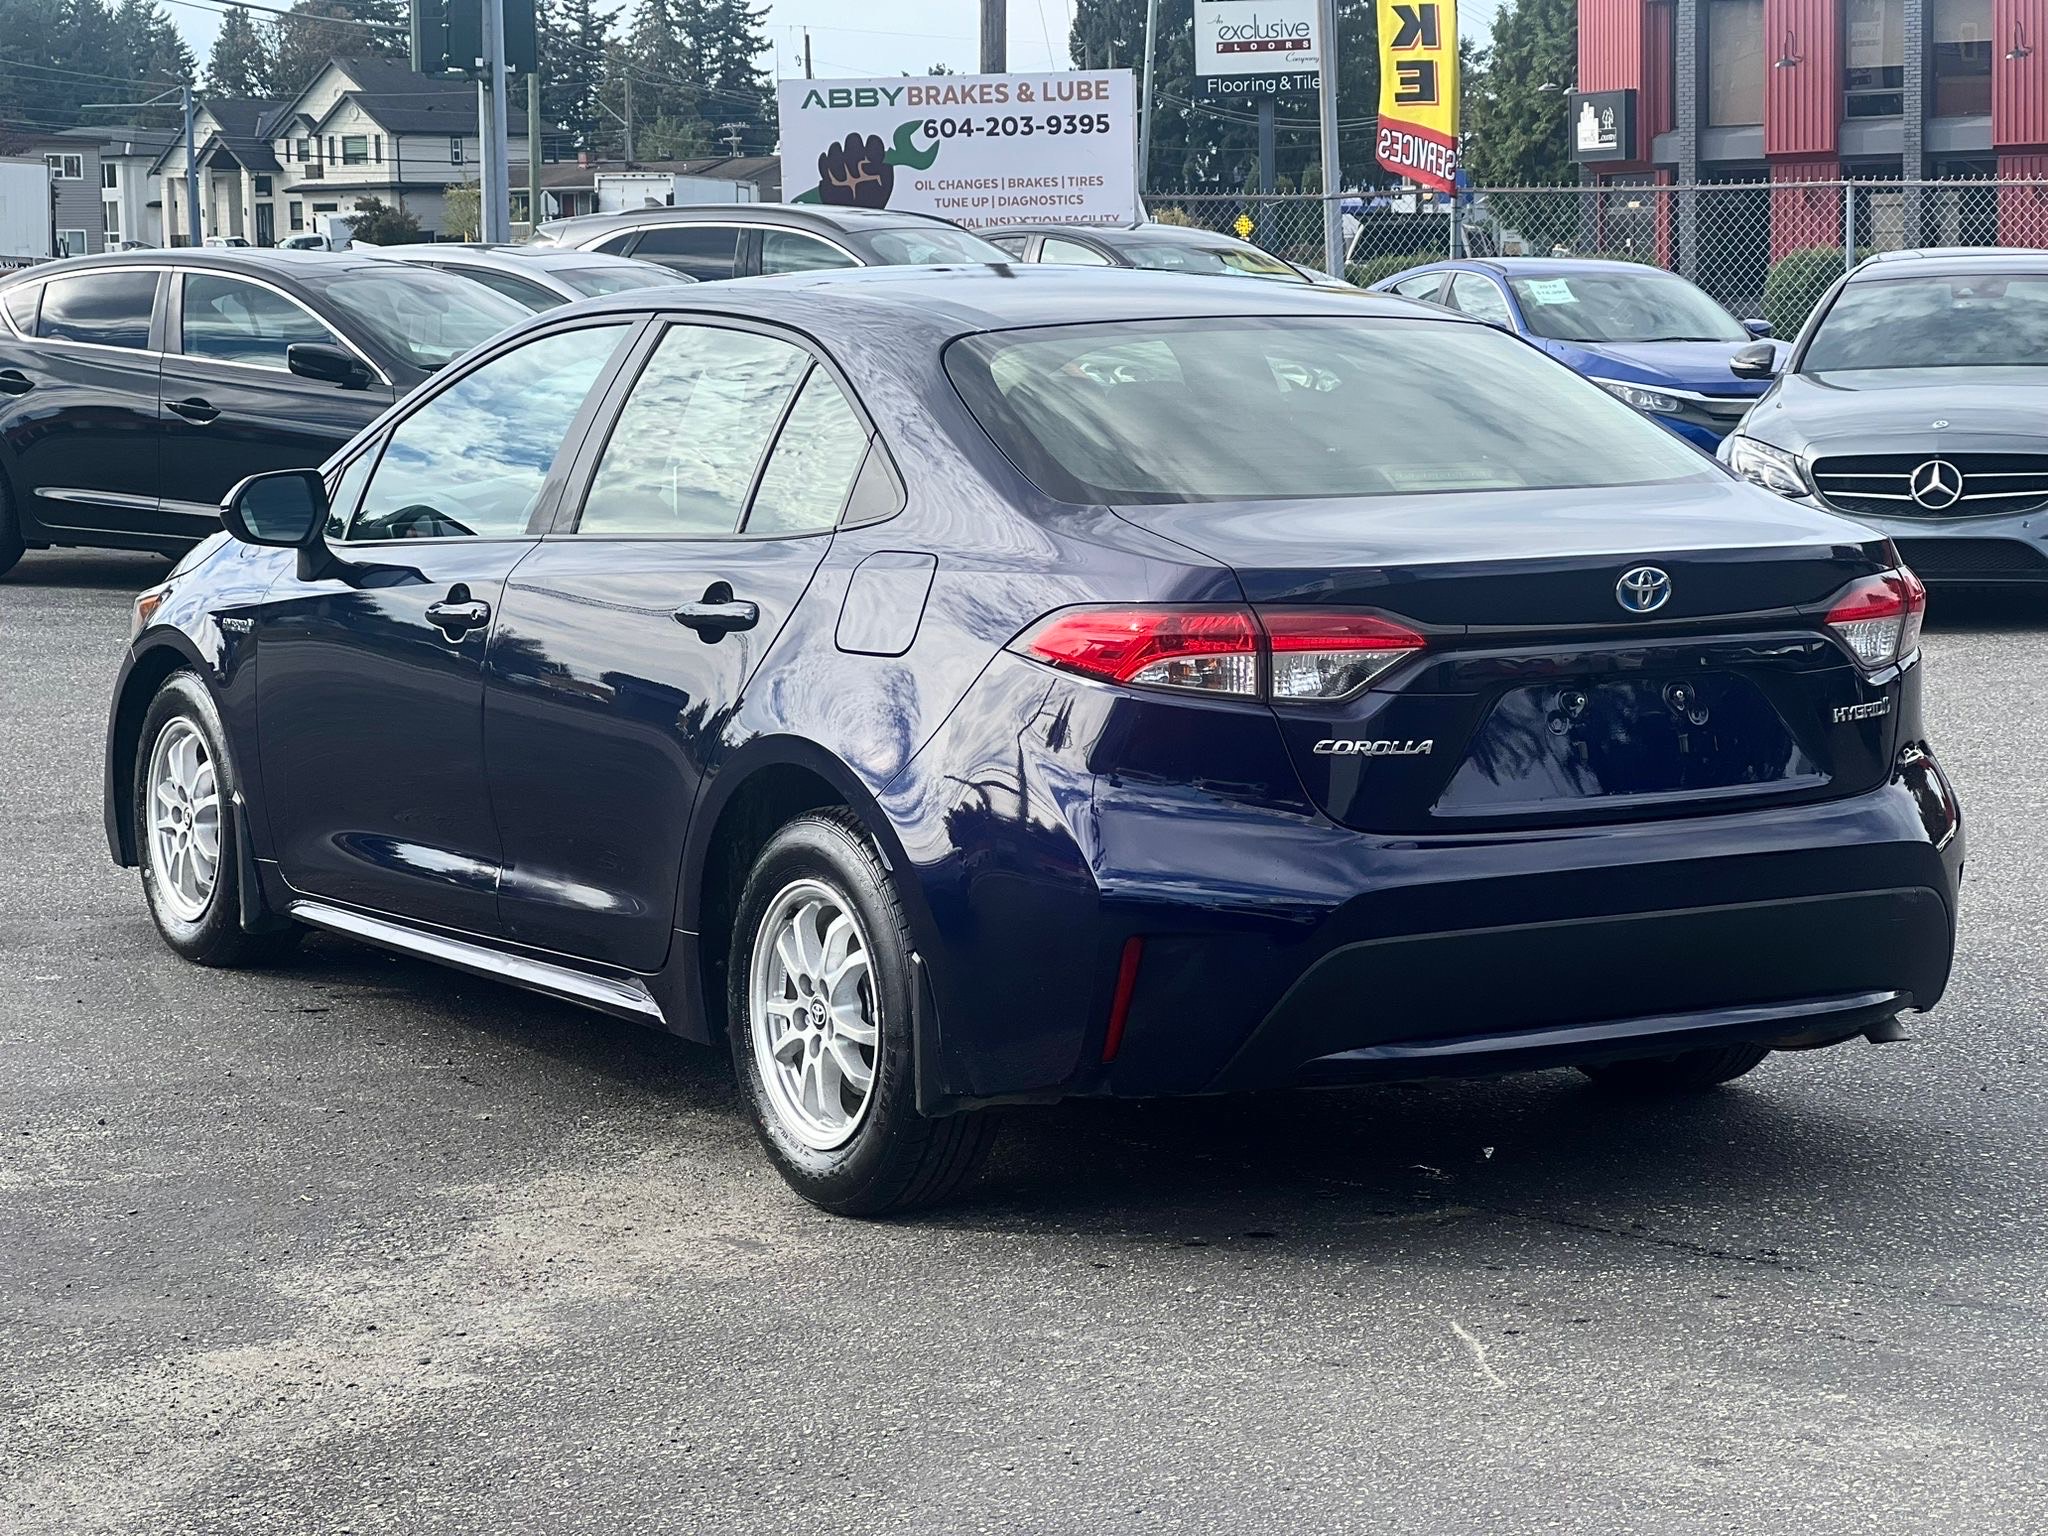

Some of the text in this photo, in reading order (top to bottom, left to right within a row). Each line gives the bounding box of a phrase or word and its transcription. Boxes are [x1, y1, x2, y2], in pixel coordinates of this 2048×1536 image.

[1218, 13, 1310, 40] exclusive
[1217, 40, 1310, 52] FLOORS
[1207, 77, 1276, 93] Flooring
[1279, 75, 1292, 91] &
[801, 80, 1110, 109] ABBY BRAKES & LUBE
[923, 113, 1110, 139] 604-203-9395
[914, 175, 1104, 191] OIL CHANGES BRAKES TIRES
[935, 194, 1084, 208] TUNE UP DIAGNOSTICS
[1833, 696, 1891, 723] HYBRID
[1313, 739, 1434, 757] COROLLA
